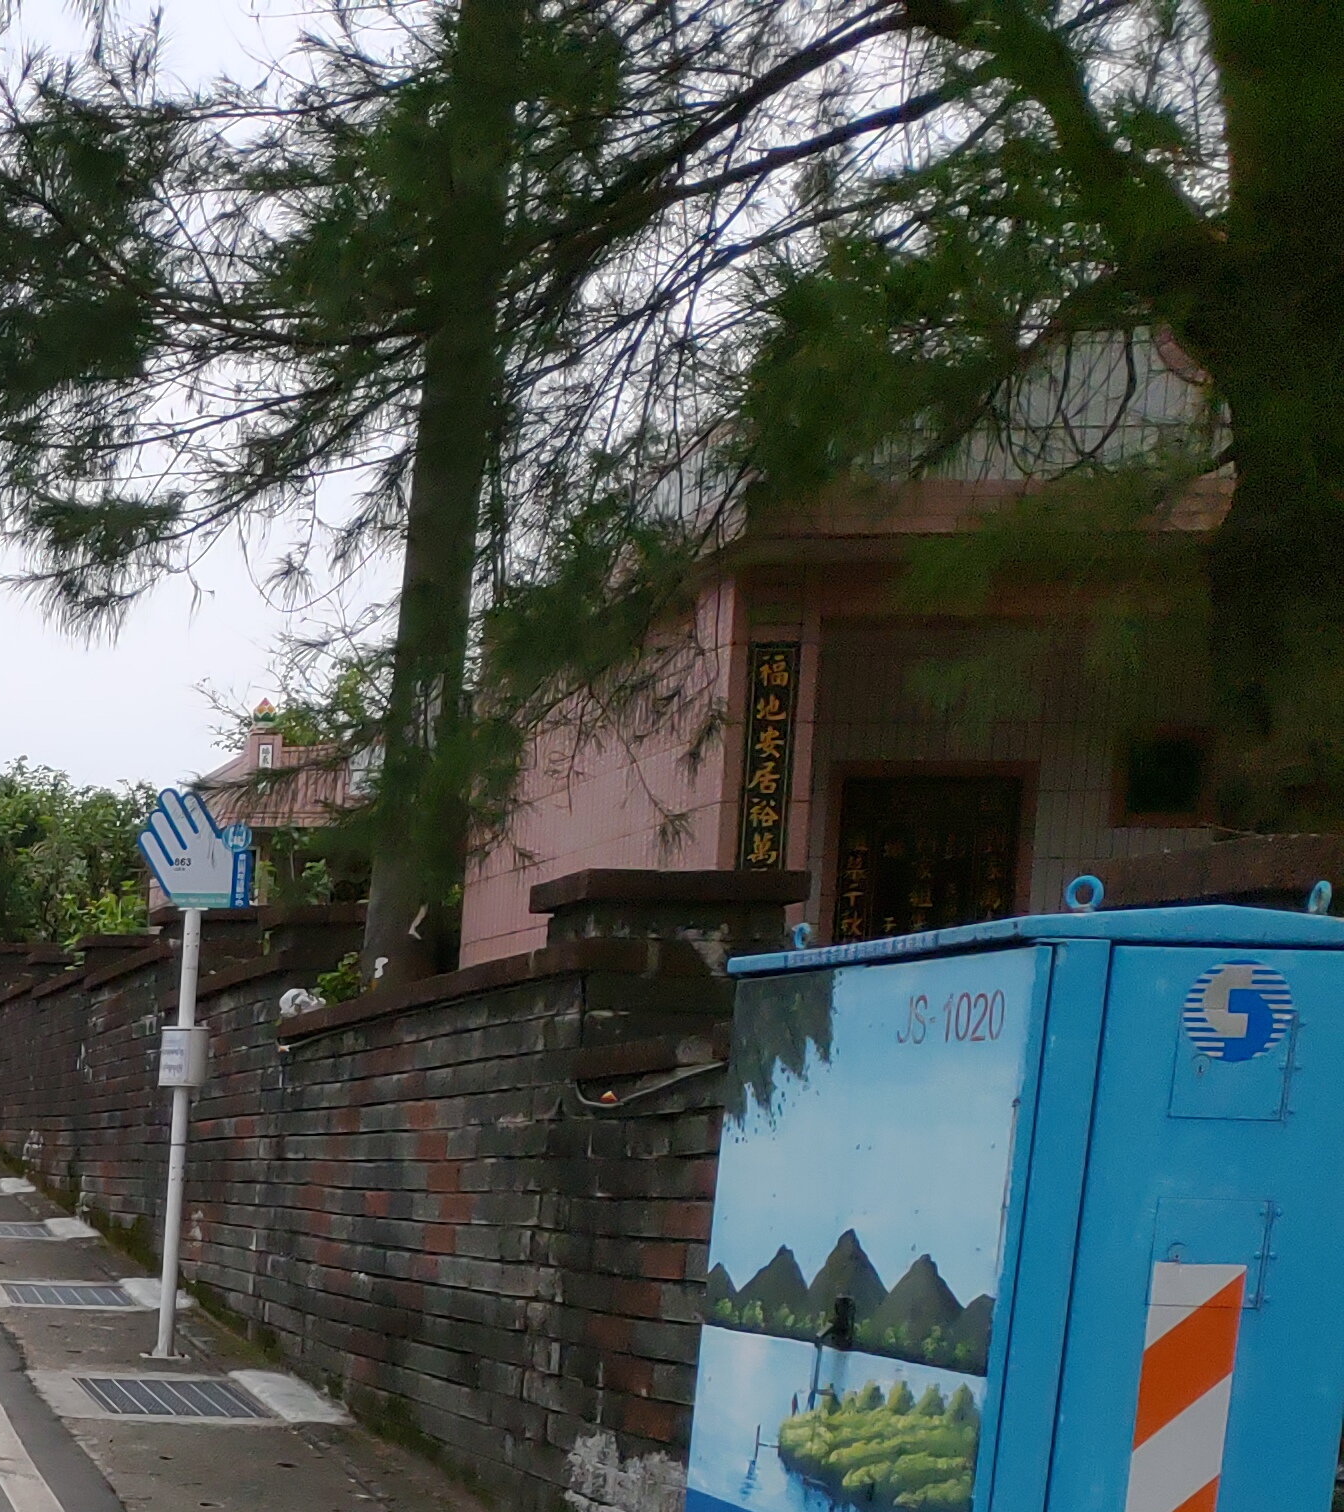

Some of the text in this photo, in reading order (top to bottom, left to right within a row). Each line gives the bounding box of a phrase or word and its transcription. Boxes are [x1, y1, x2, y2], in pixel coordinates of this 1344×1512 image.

[746, 653, 789, 871] 福地安居裕萬
[896, 989, 1005, 1044] JS-1020
